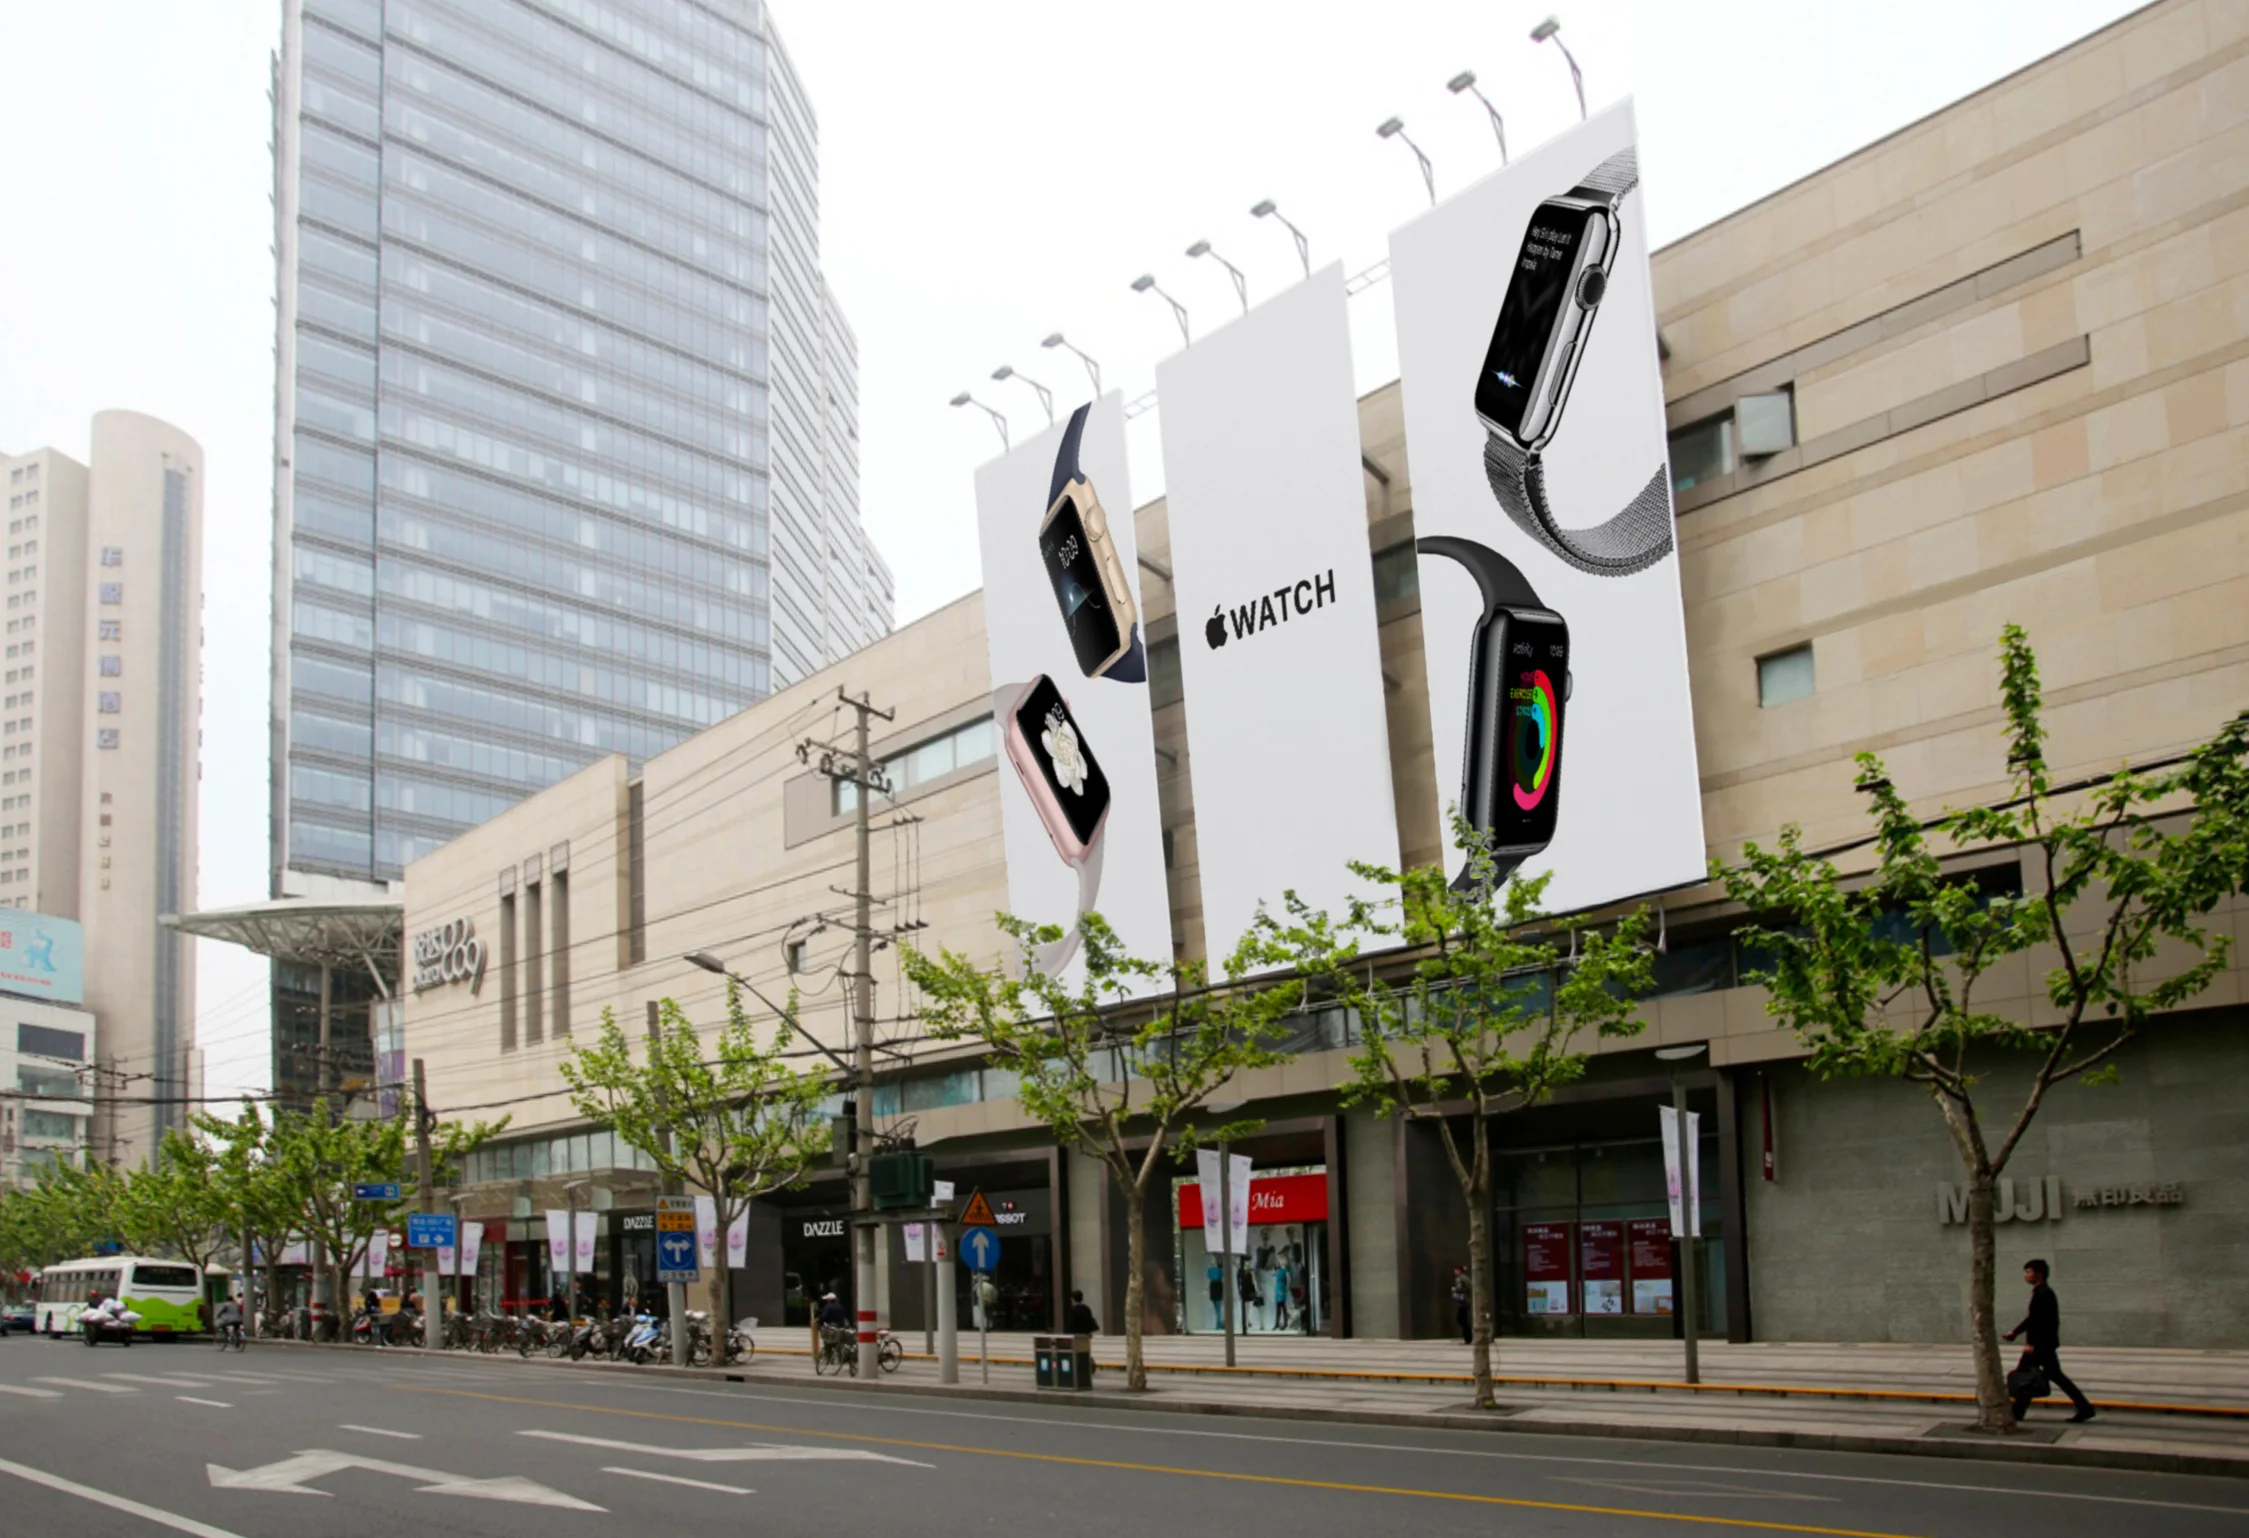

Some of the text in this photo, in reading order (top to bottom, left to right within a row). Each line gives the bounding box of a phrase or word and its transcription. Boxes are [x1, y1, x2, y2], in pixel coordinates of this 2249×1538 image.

[1229, 568, 1336, 640] WATCH
[1251, 1190, 1284, 1210] Mia
[623, 1215, 654, 1230] DAZZLE
[803, 1220, 844, 1237] DAZZLE
